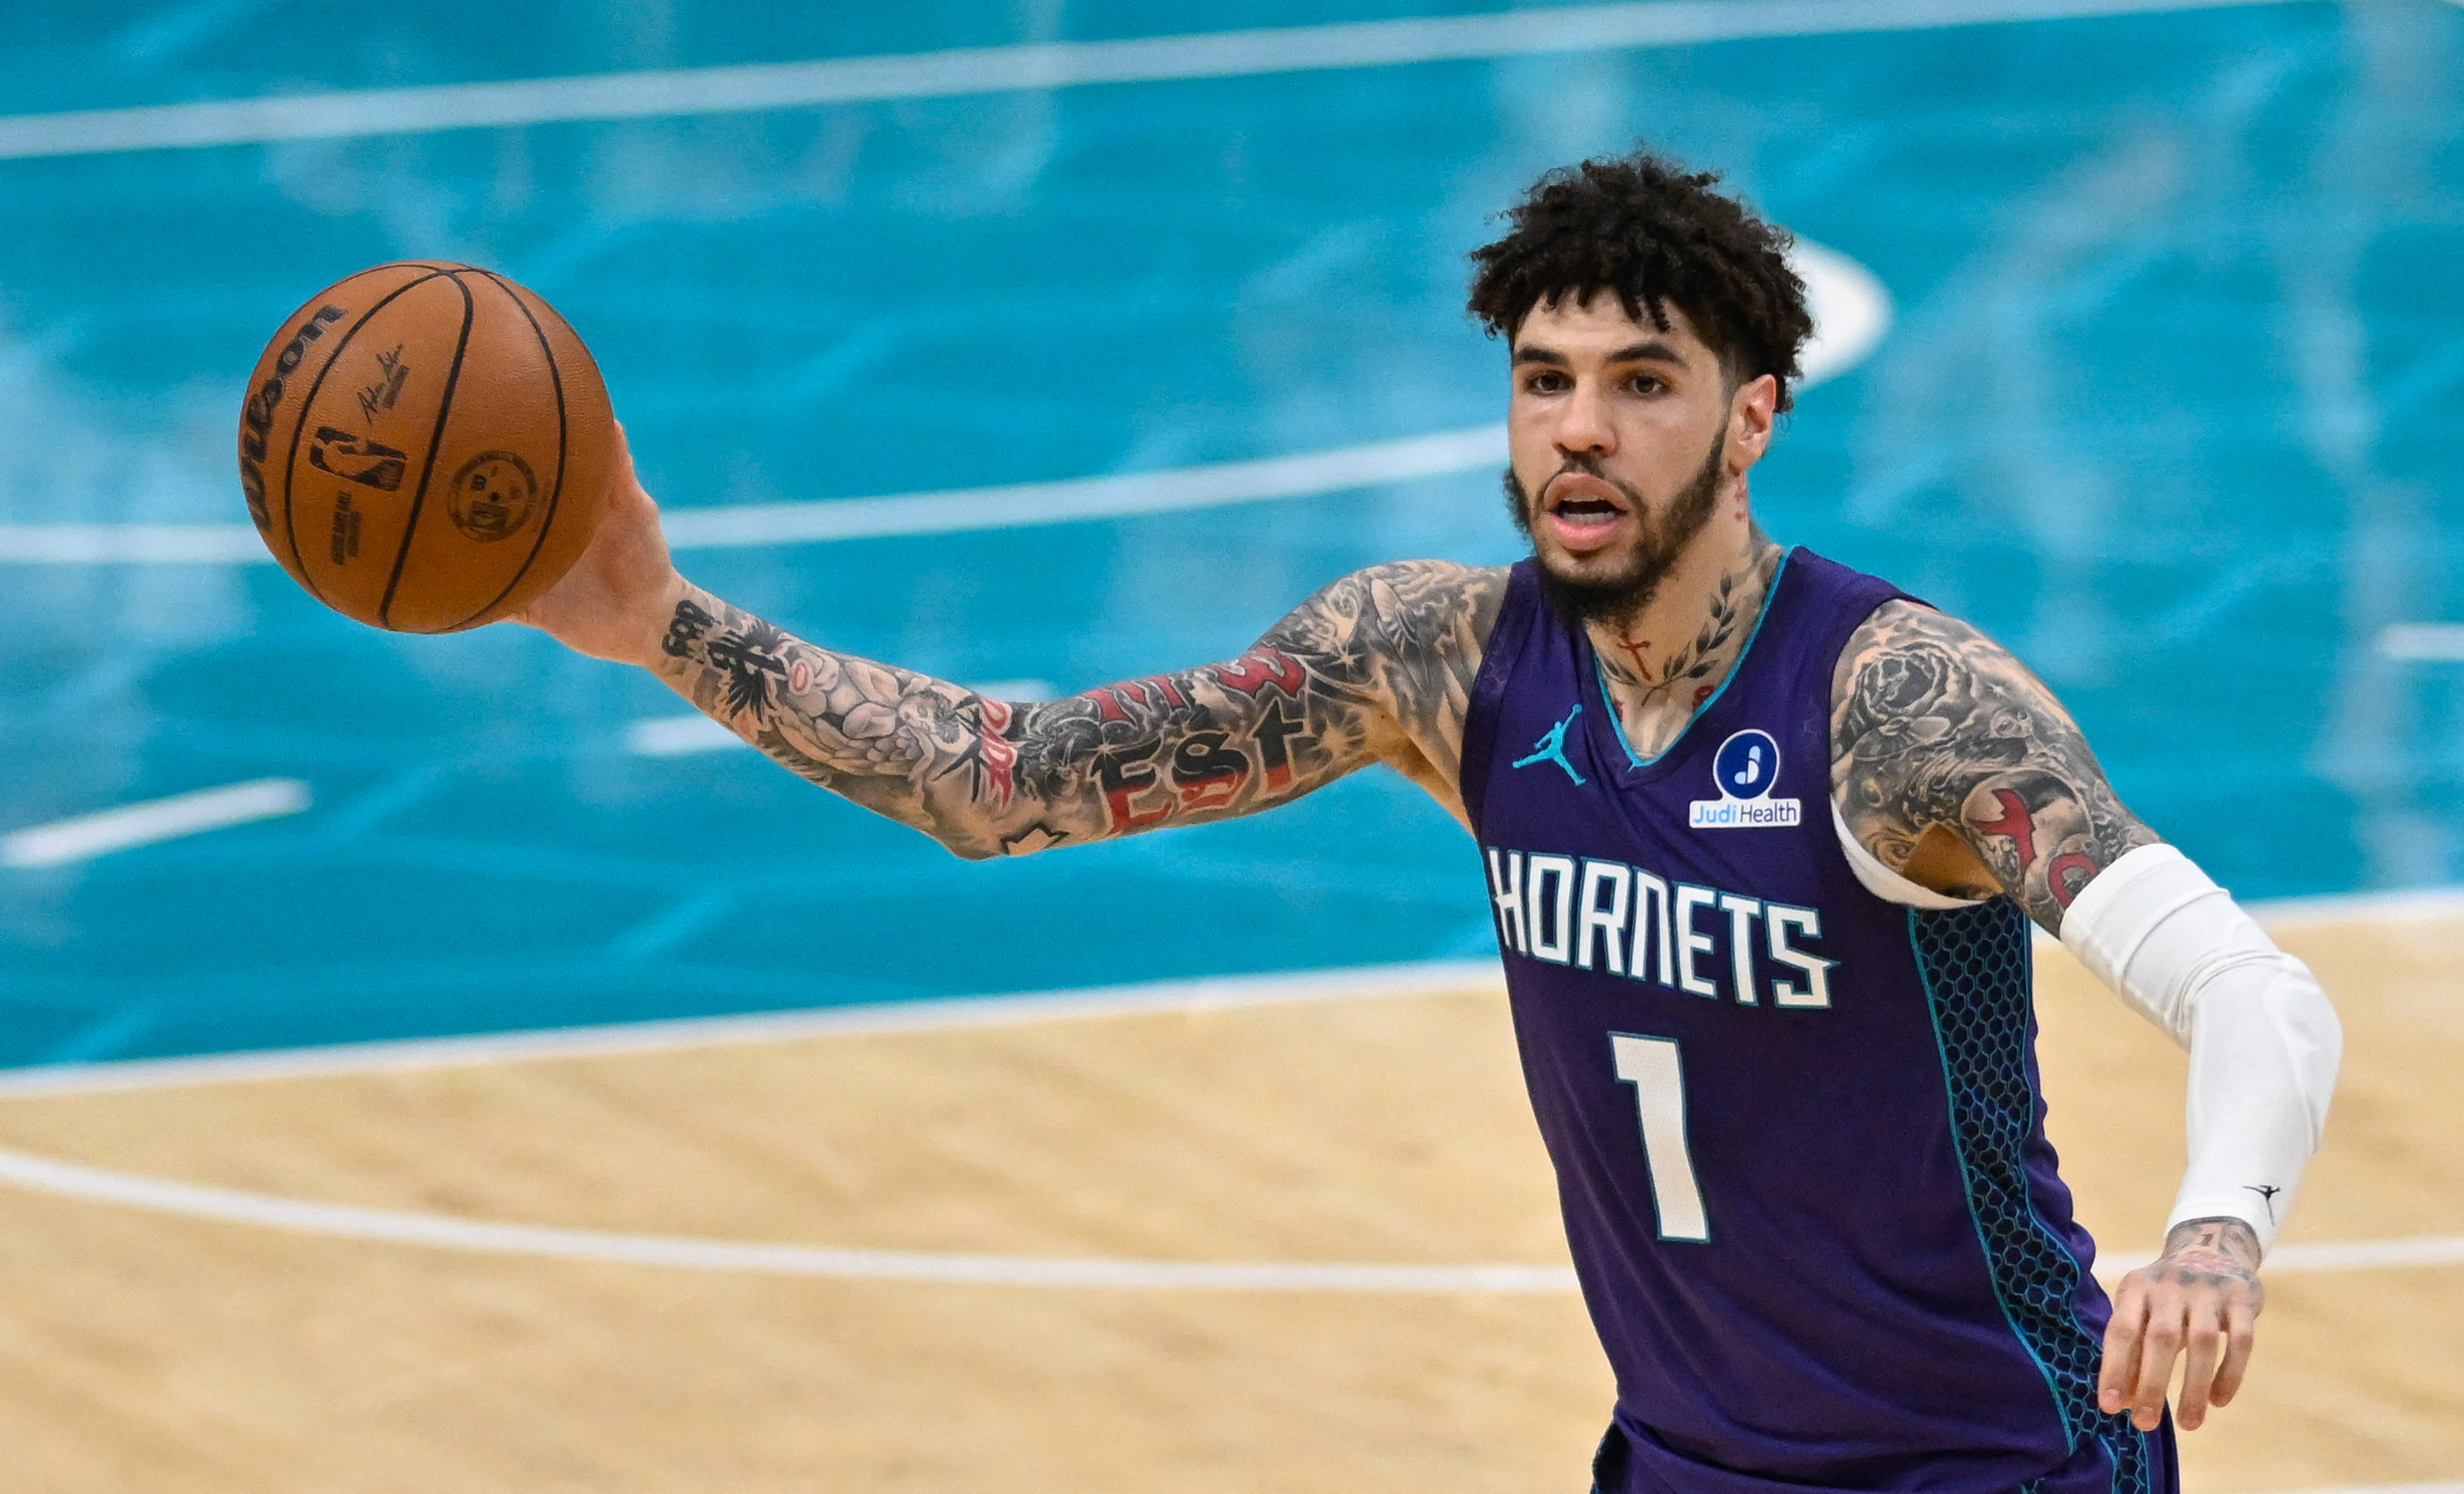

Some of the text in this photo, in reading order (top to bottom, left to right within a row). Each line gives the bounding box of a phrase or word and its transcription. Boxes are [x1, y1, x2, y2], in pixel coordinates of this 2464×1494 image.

[1693, 801, 1797, 823] Judi Health
[1487, 846, 1841, 1009] HORNETS
[1607, 1030, 1710, 1244] 1
